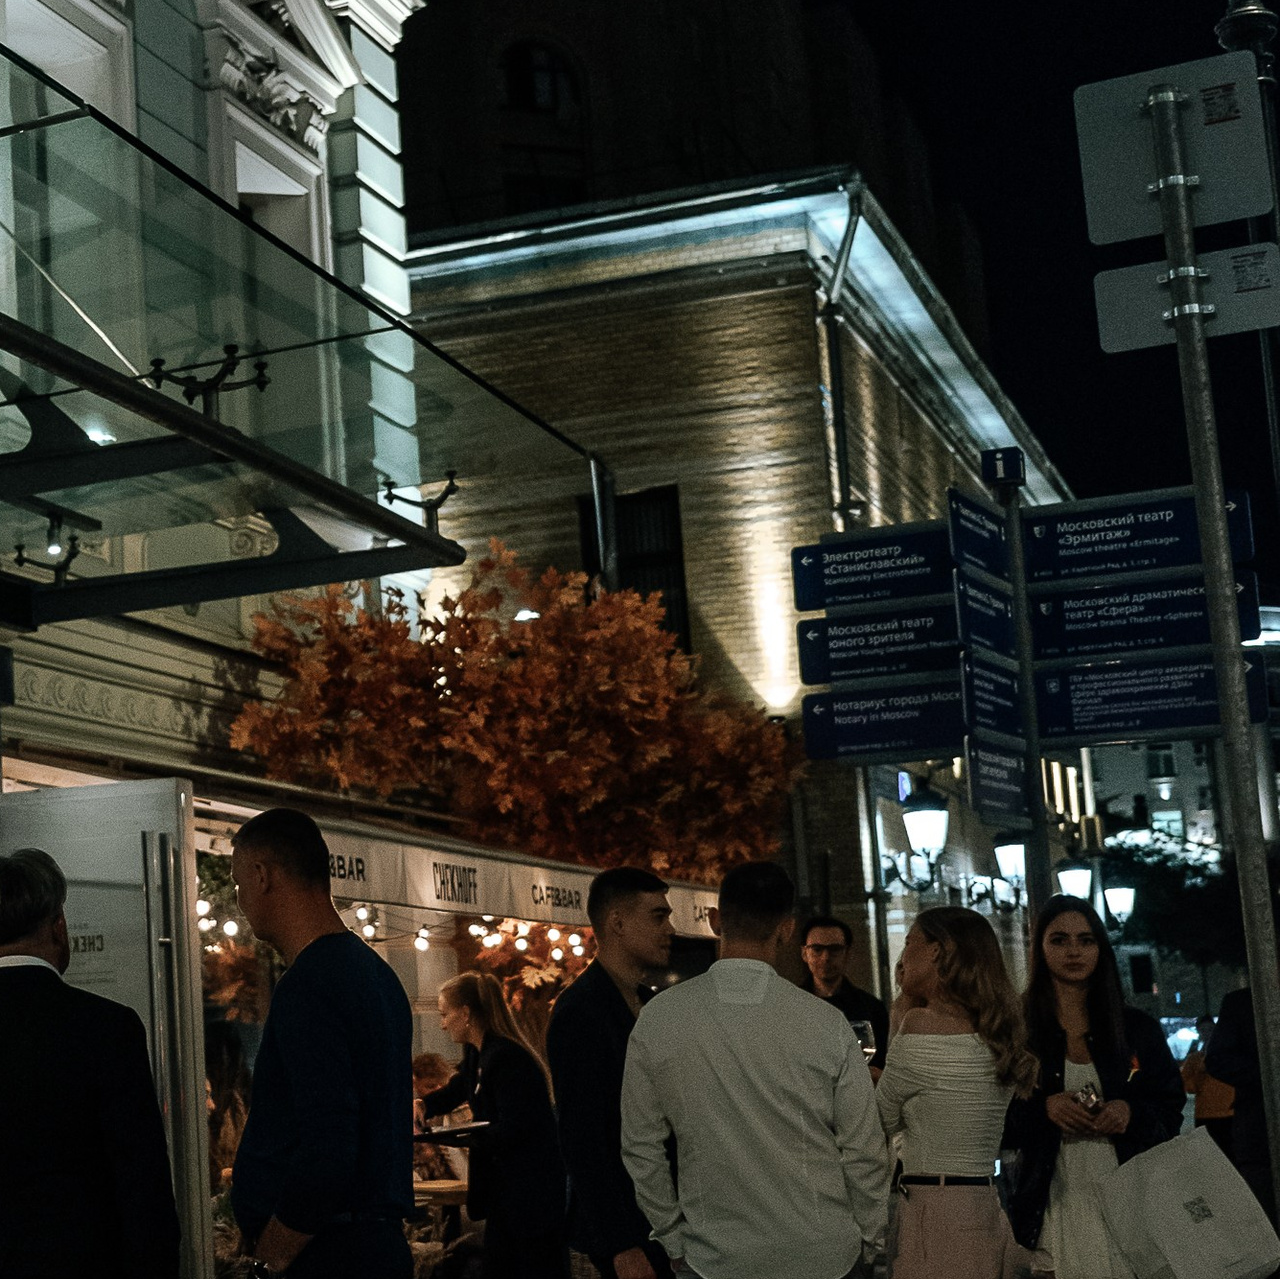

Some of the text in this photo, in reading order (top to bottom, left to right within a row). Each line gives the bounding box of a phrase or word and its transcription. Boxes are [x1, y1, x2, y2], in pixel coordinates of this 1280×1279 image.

[1056, 510, 1174, 533] Московский театр
[1058, 529, 1132, 546] «Эрмитаж»
[822, 545, 902, 564] Электротеатр
[1058, 546, 1093, 556] Moscow
[824, 555, 926, 575] «Станиславский»
[1063, 587, 1206, 609] Московский драматическ
[1064, 604, 1146, 620] театр «Сфера»
[827, 616, 935, 637] Московский театр
[828, 631, 916, 649] юного зрителя
[833, 690, 962, 712] Нотариус города Моск
[834, 709, 920, 724] Notary in Moscow
[329, 853, 366, 882] &BAR
[432, 861, 478, 904] CHEKHOFF
